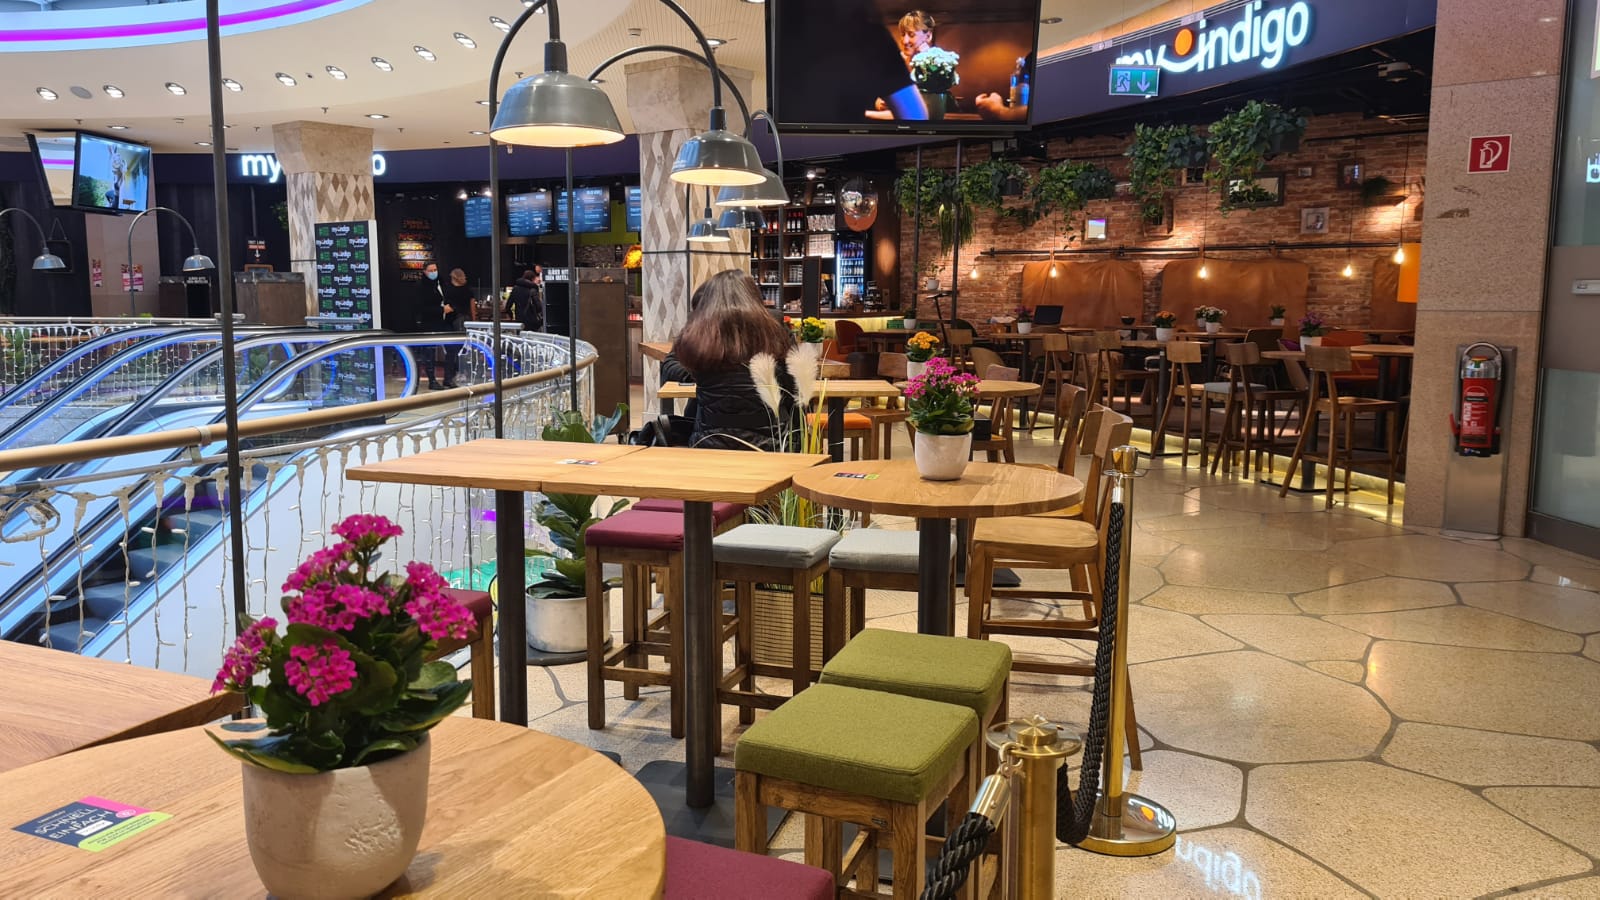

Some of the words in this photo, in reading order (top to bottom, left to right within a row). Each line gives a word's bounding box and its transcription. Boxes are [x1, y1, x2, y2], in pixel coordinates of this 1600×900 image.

[1197, 0, 1310, 72] indigo
[241, 154, 281, 183] my
[34, 808, 98, 835] SCHNELL
[49, 810, 114, 840] EINFACH
